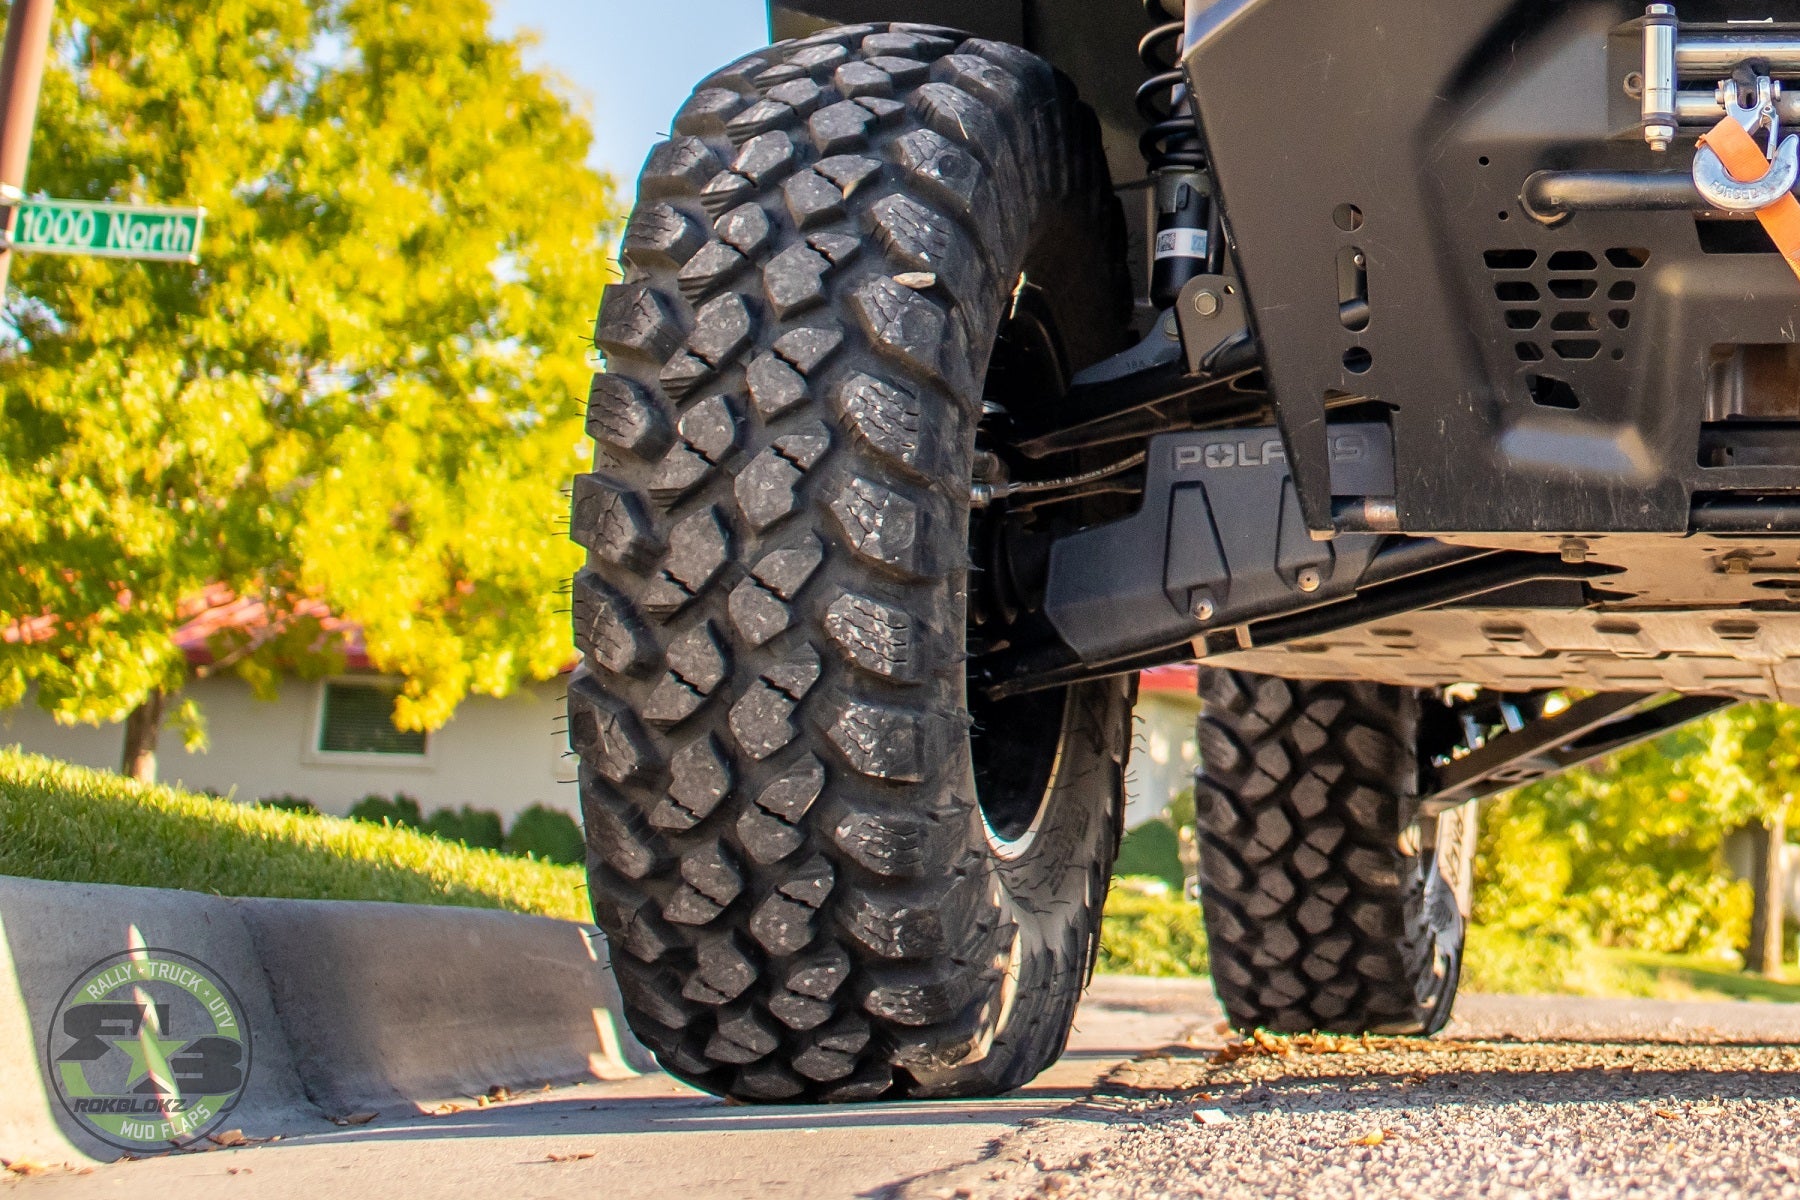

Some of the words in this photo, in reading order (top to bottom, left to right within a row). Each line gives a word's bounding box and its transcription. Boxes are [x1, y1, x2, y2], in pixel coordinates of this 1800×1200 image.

[22, 206, 96, 244] 1000
[106, 213, 191, 250] North
[1175, 434, 1361, 471] POLAIS
